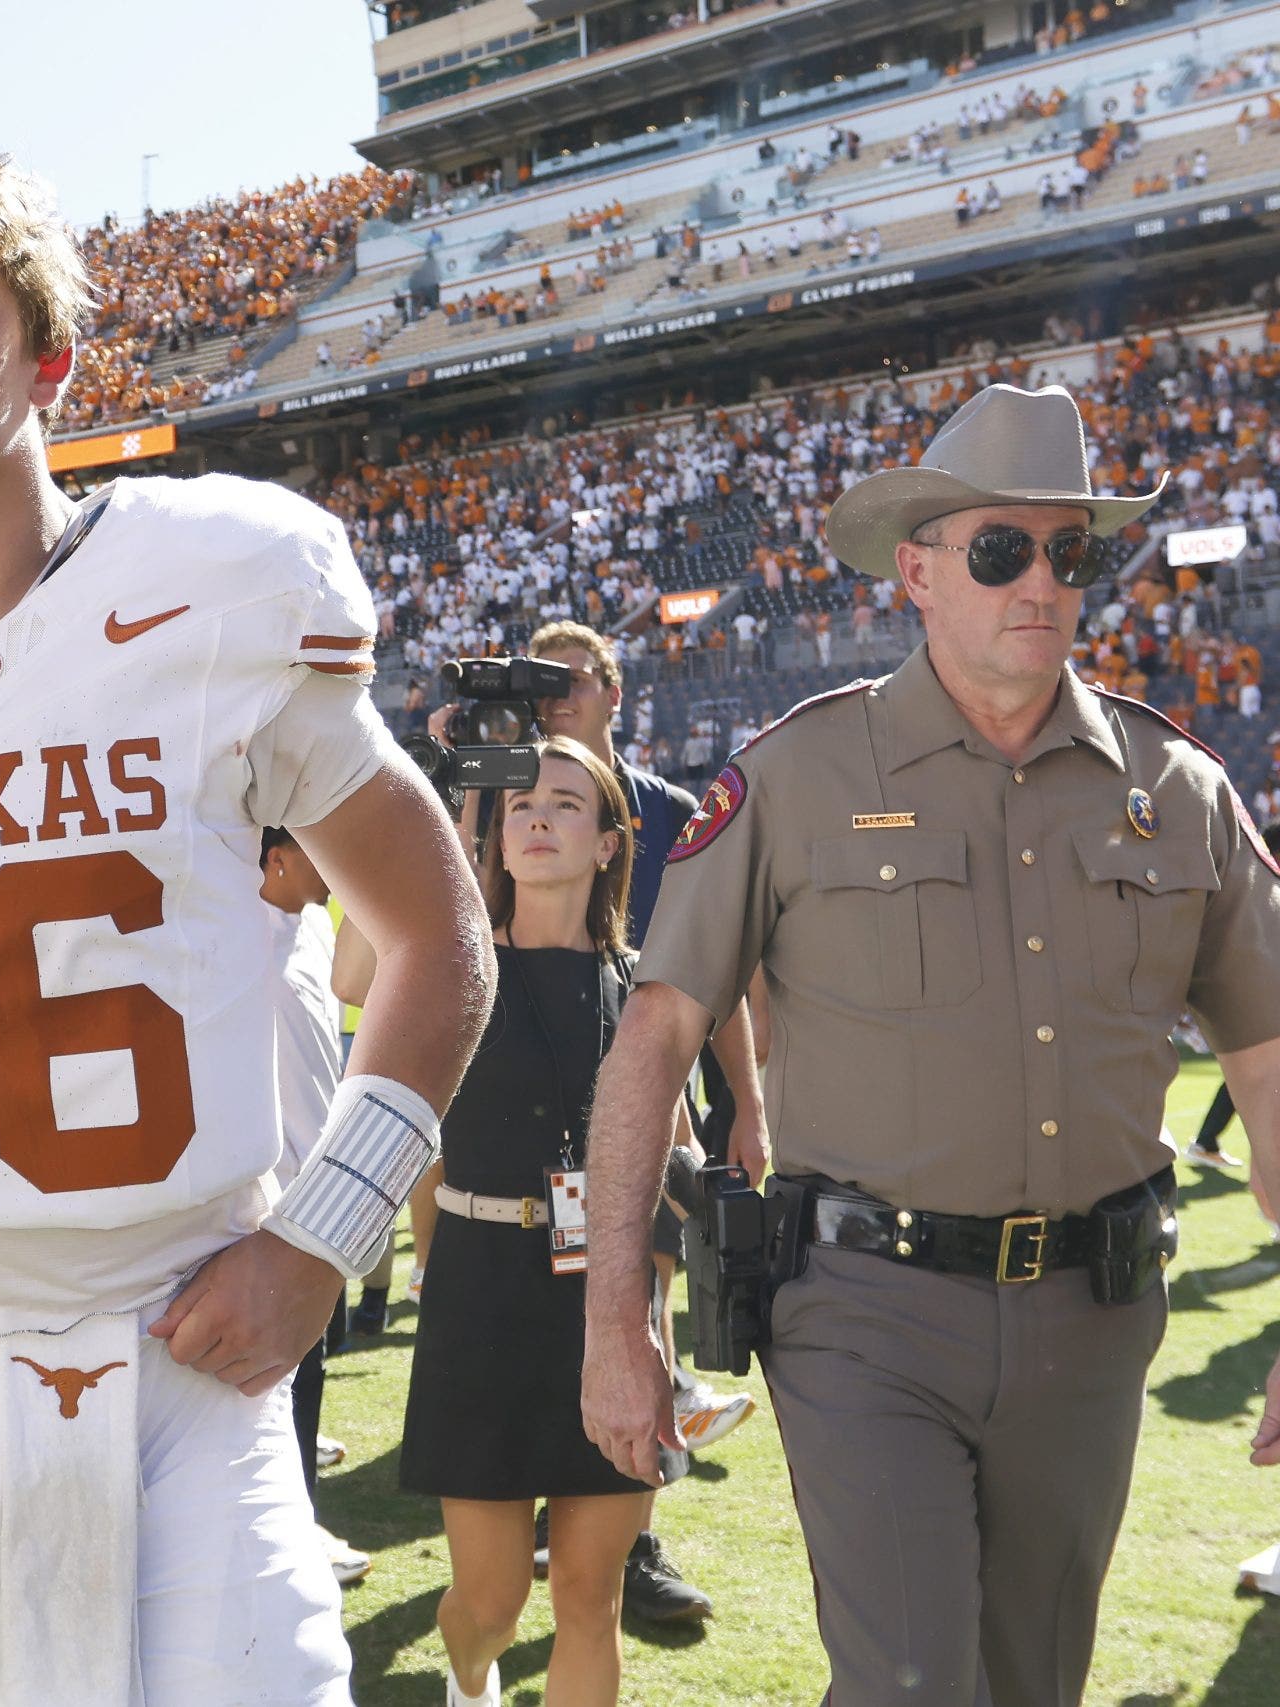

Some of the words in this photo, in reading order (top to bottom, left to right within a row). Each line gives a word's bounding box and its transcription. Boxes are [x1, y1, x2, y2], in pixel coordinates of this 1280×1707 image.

[801, 282, 853, 305] CLYDE
[603, 323, 654, 345] WILLIS
[657, 310, 717, 334] TUCKER
[282, 397, 309, 412] BILL
